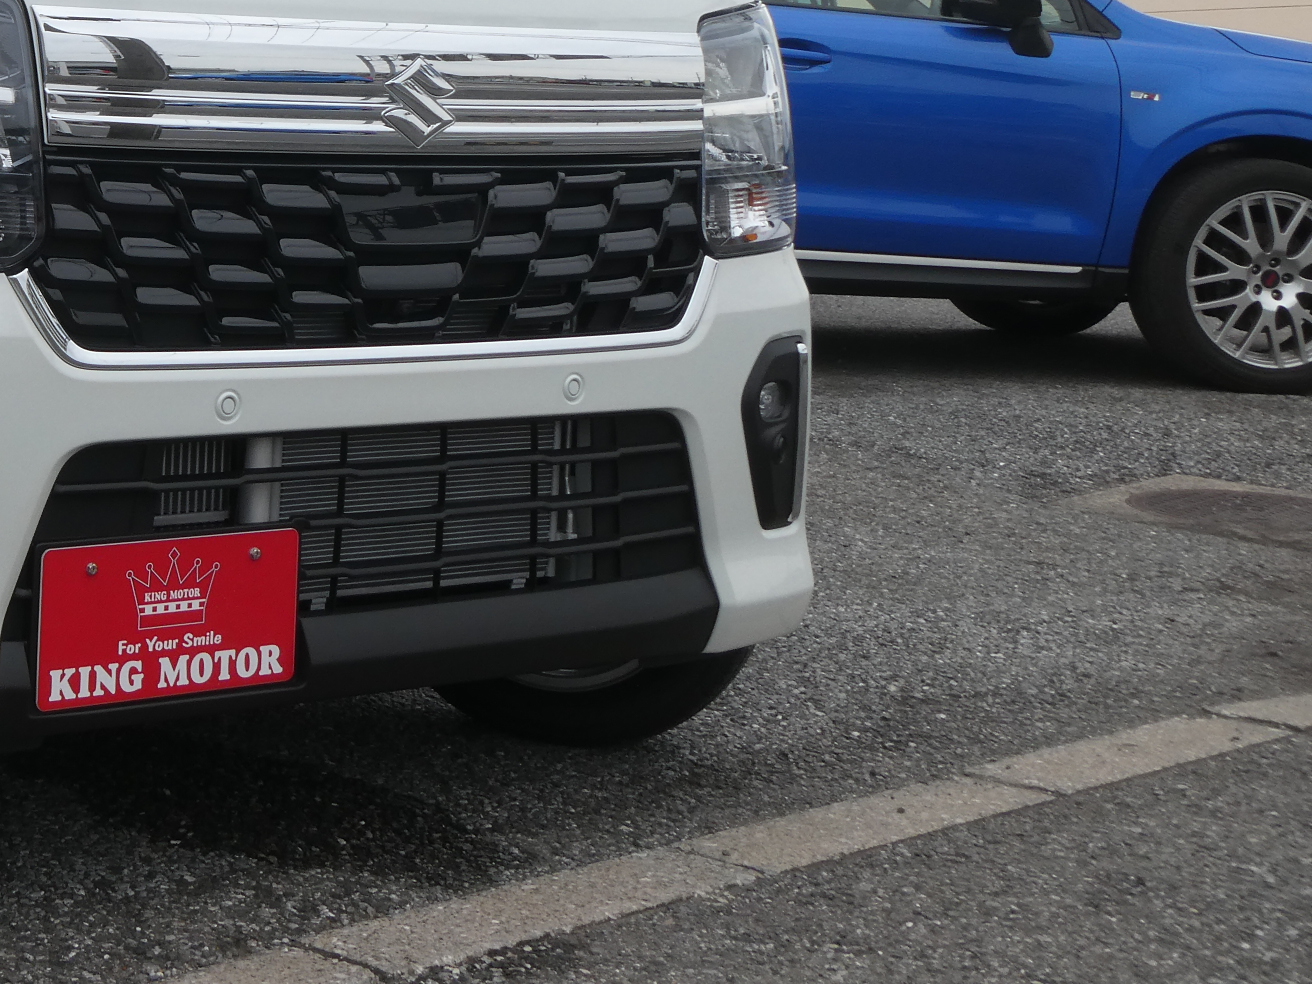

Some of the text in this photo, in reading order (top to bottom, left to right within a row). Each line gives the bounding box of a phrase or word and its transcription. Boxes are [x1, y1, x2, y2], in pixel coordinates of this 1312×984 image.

[144, 587, 201, 603] KING MOTOR
[117, 630, 223, 656] For Your Smile
[48, 644, 284, 703] KING MOTOR
